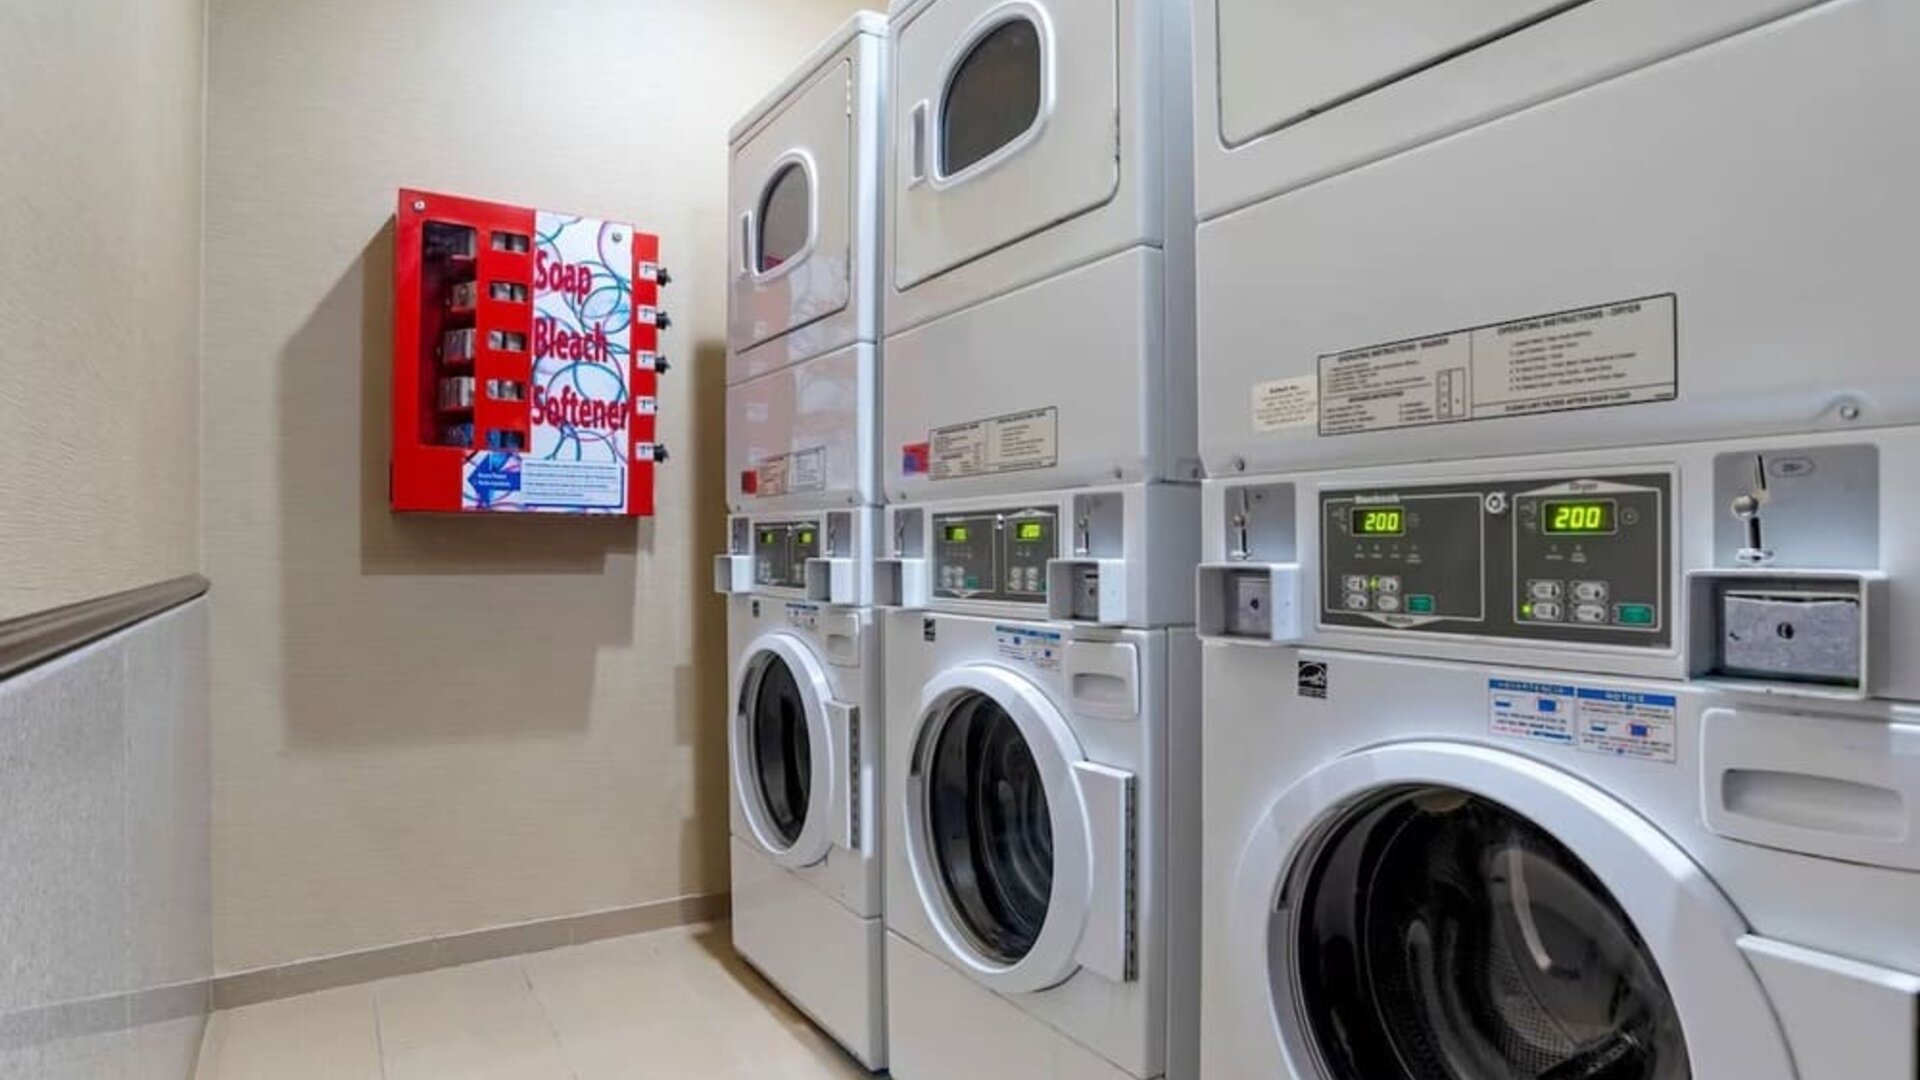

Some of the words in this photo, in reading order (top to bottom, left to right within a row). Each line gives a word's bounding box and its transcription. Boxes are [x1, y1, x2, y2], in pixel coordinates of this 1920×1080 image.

[535, 251, 592, 303] Soap
[534, 317, 608, 363] Bleach
[531, 385, 630, 430] Softener
[1363, 512, 1399, 531] 200
[1554, 506, 1601, 529] 200
